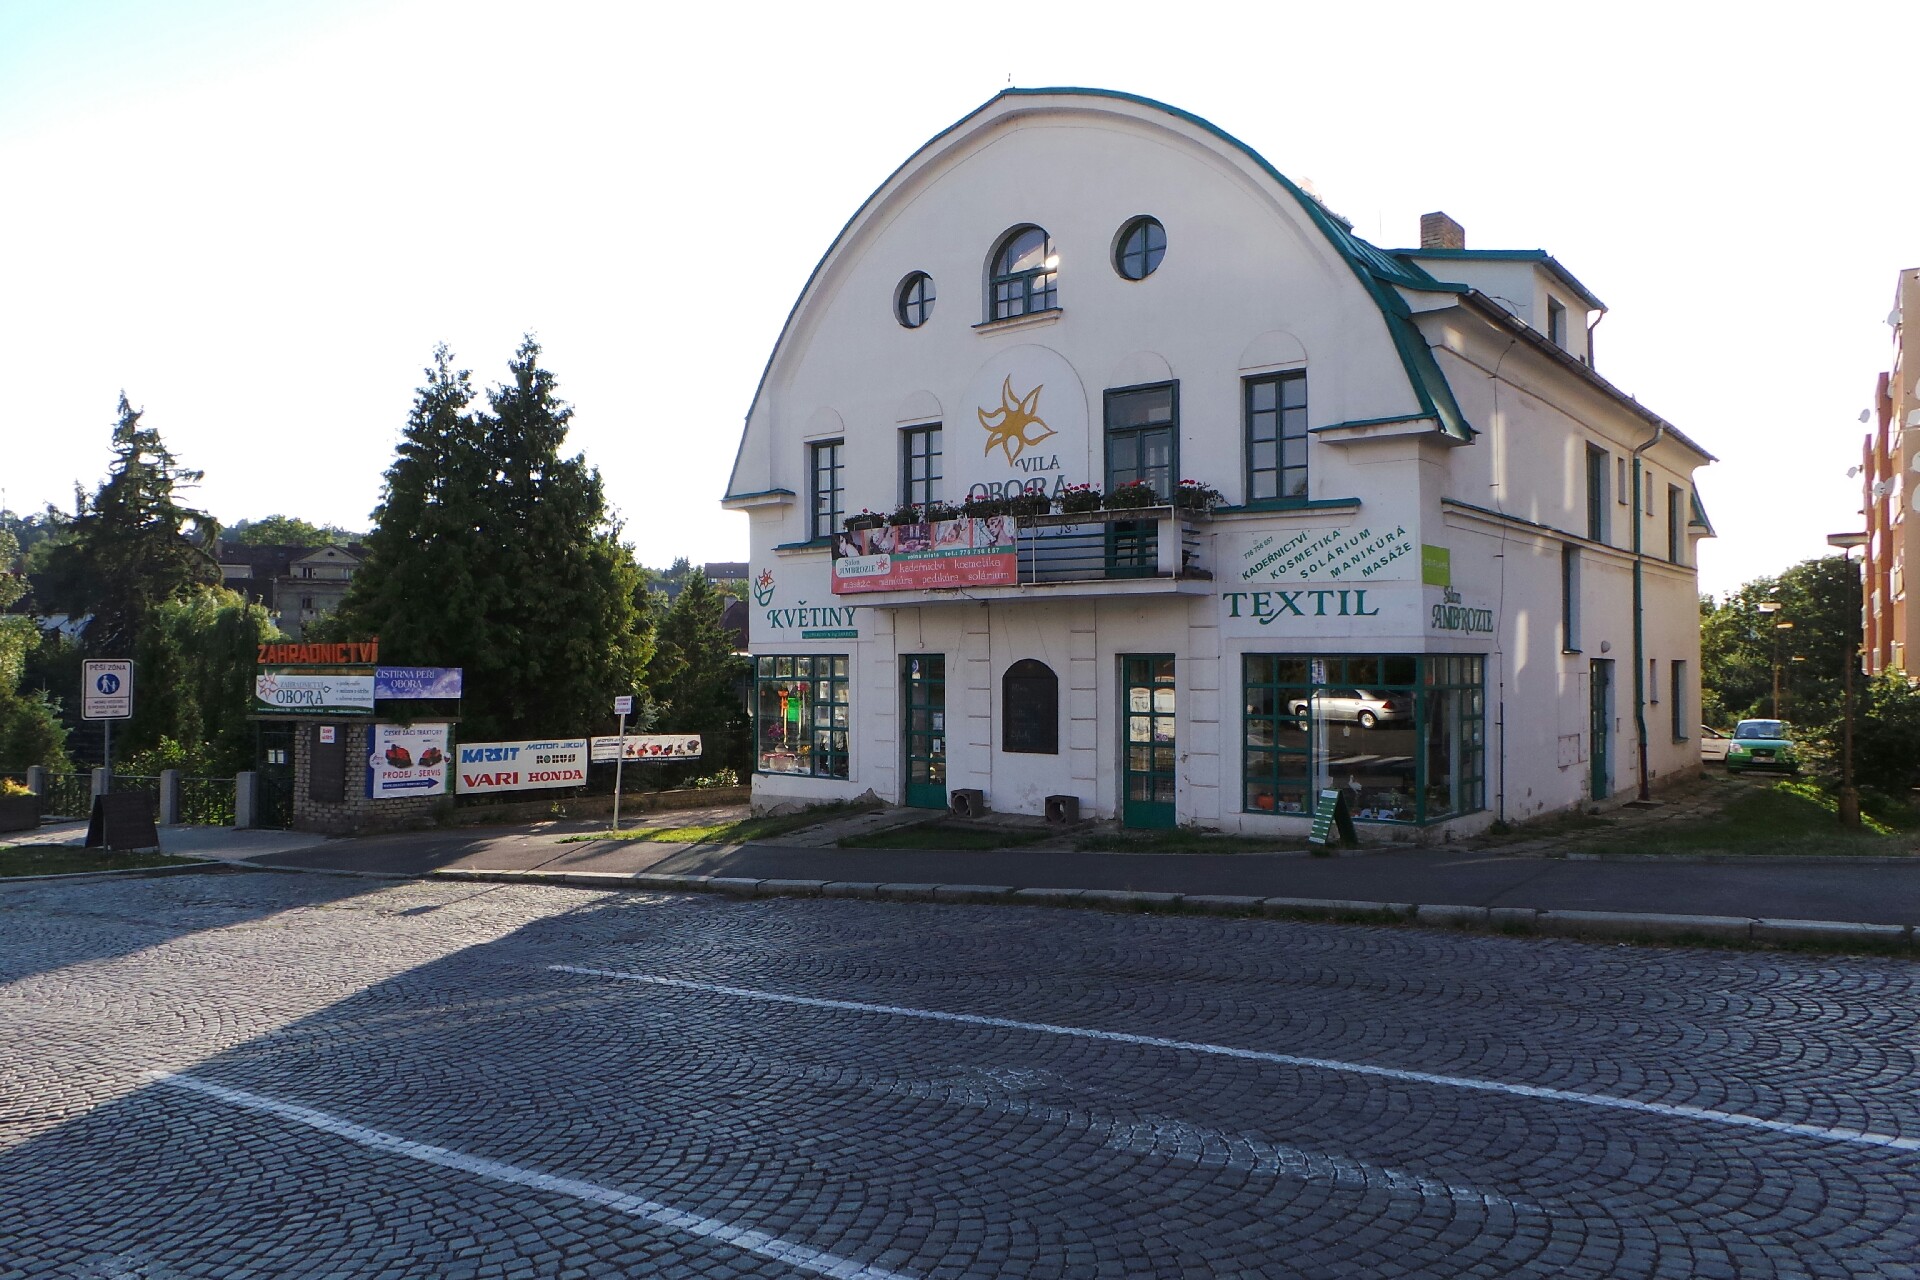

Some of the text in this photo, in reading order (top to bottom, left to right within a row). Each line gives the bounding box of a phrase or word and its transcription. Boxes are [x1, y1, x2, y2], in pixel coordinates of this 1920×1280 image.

[1015, 454, 1061, 472] VILA
[968, 474, 1066, 501] OBORA
[1241, 530, 1308, 581] KADEŘNICTVÍ
[1270, 530, 1341, 580] KOSMETIKA
[1300, 528, 1371, 579] SOLÁRIUM
[1361, 542, 1413, 578] MASÁŽE
[954, 558, 1001, 570] kosmetika
[968, 570, 1010, 581] solárium
[766, 600, 856, 628] KVĚTINY
[1223, 589, 1380, 625] TEXTIL
[257, 637, 379, 665] ZAHRADNICTVÍ
[390, 679, 423, 689] OBORA
[276, 689, 324, 706] OBORA
[461, 747, 520, 763] KARSIT
[525, 741, 586, 751] MOTOR JIKOV
[382, 770, 413, 780] PRODEJ
[418, 769, 442, 778] SERVIS
[462, 769, 584, 788] VARI HONDA
